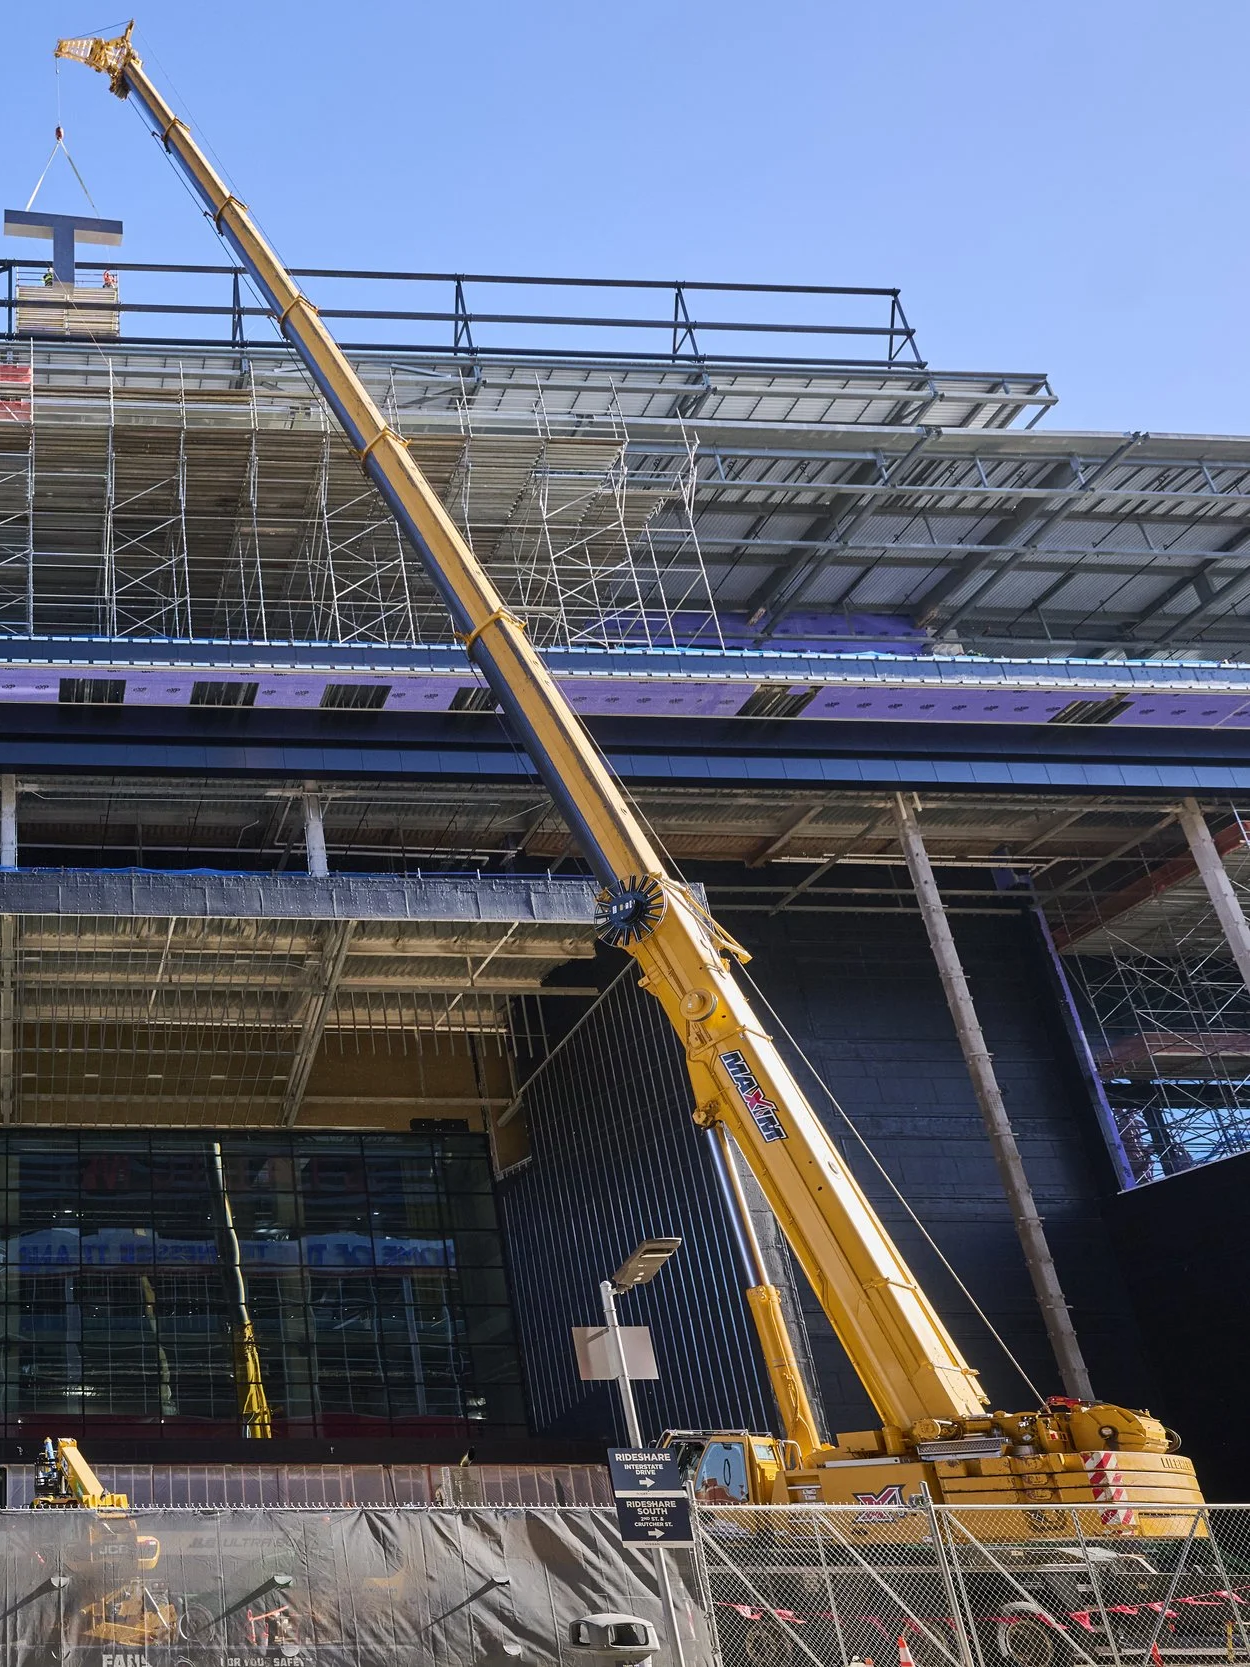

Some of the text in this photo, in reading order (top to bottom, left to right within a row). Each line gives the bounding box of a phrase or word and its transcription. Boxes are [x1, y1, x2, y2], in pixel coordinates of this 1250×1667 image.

[719, 1049, 789, 1143] MAXIM
[615, 1453, 671, 1461] RIDESHARE
[223, 1537, 271, 1548] ULTRA
